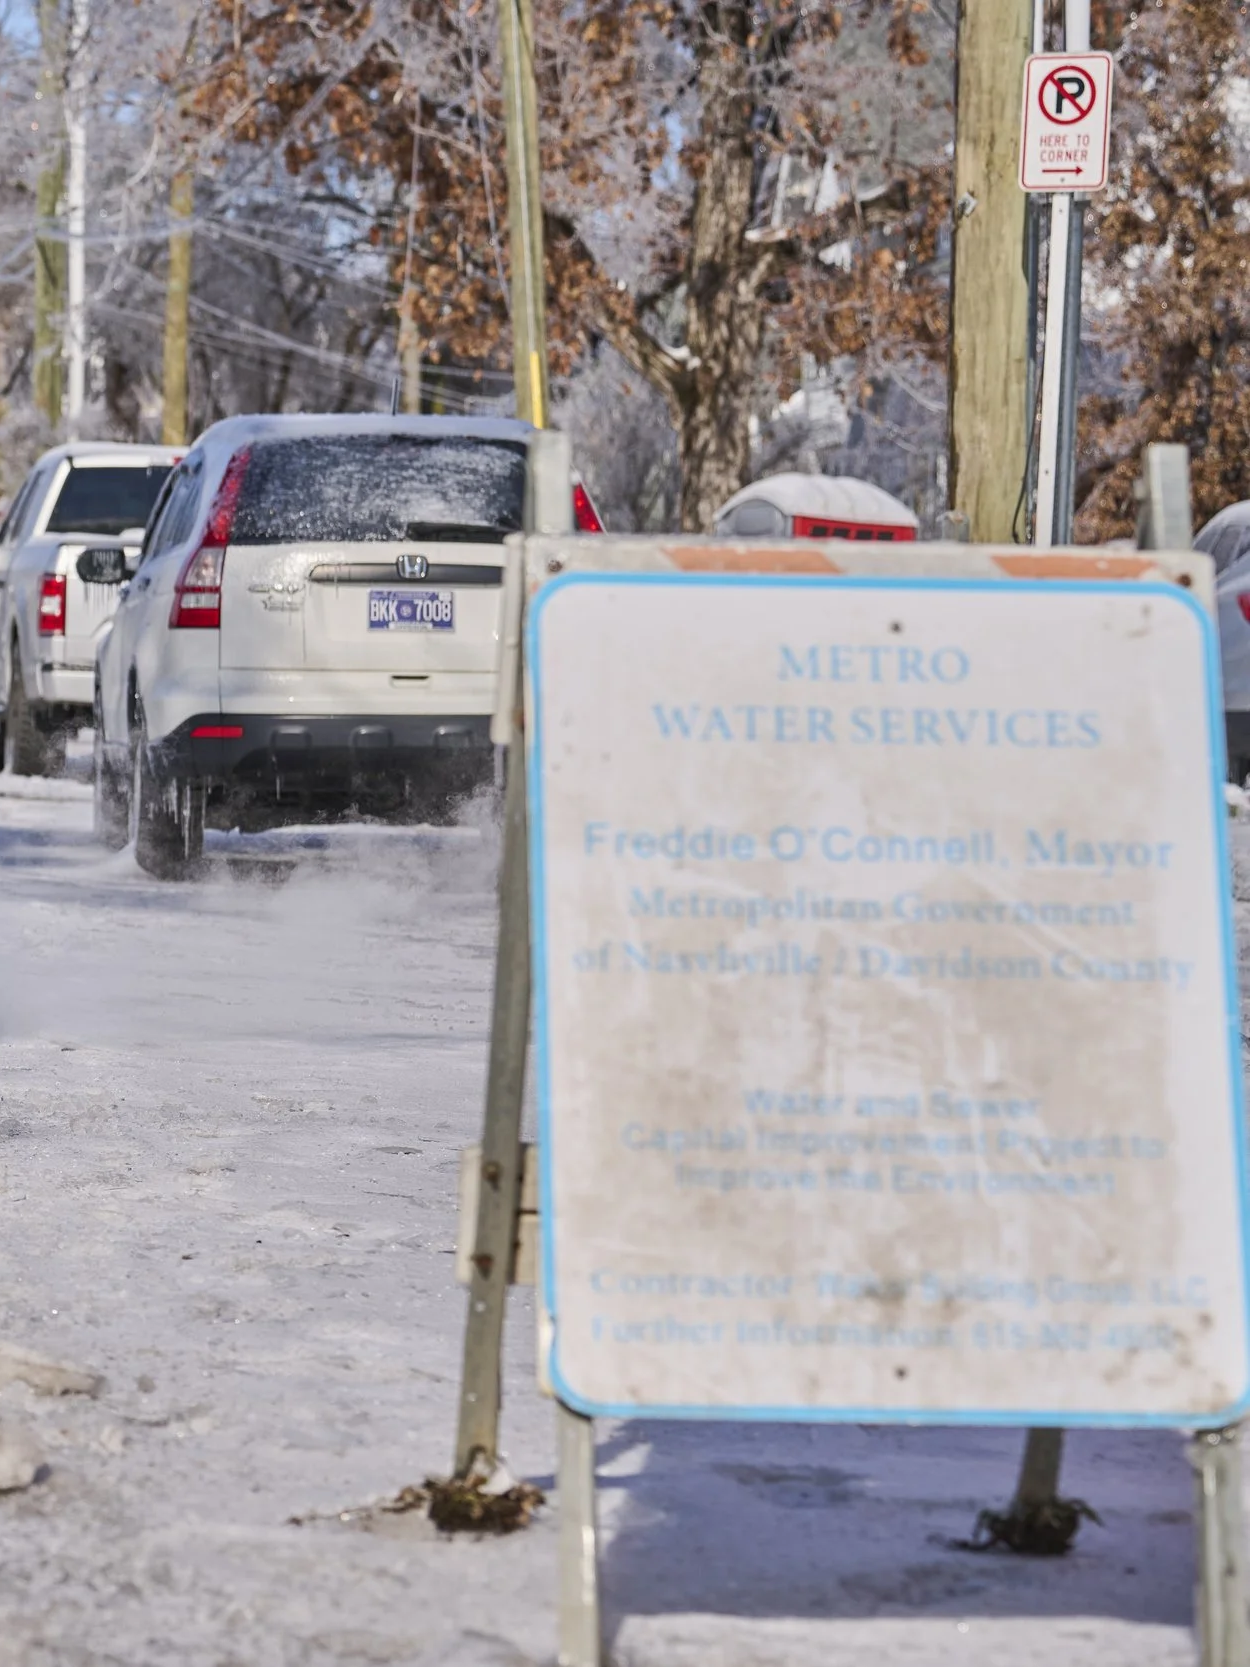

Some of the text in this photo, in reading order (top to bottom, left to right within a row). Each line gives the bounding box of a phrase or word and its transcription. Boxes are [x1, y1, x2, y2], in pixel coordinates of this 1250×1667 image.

[1040, 134, 1090, 147] HERE TO
[1040, 149, 1088, 163] CORNER
[370, 600, 451, 621] BKK 7008
[777, 644, 970, 684] METRO
[651, 703, 1102, 748] WATER SERVICES
[584, 820, 1176, 877] Freddie O'Connell, Mayor
[628, 885, 1135, 929] Metropolitan Government
[571, 942, 610, 973] of
[859, 944, 1043, 980] Davidson
[1051, 953, 1196, 992] County
[745, 1090, 1041, 1117] Water and Sewer
[621, 1121, 745, 1154] Capital
